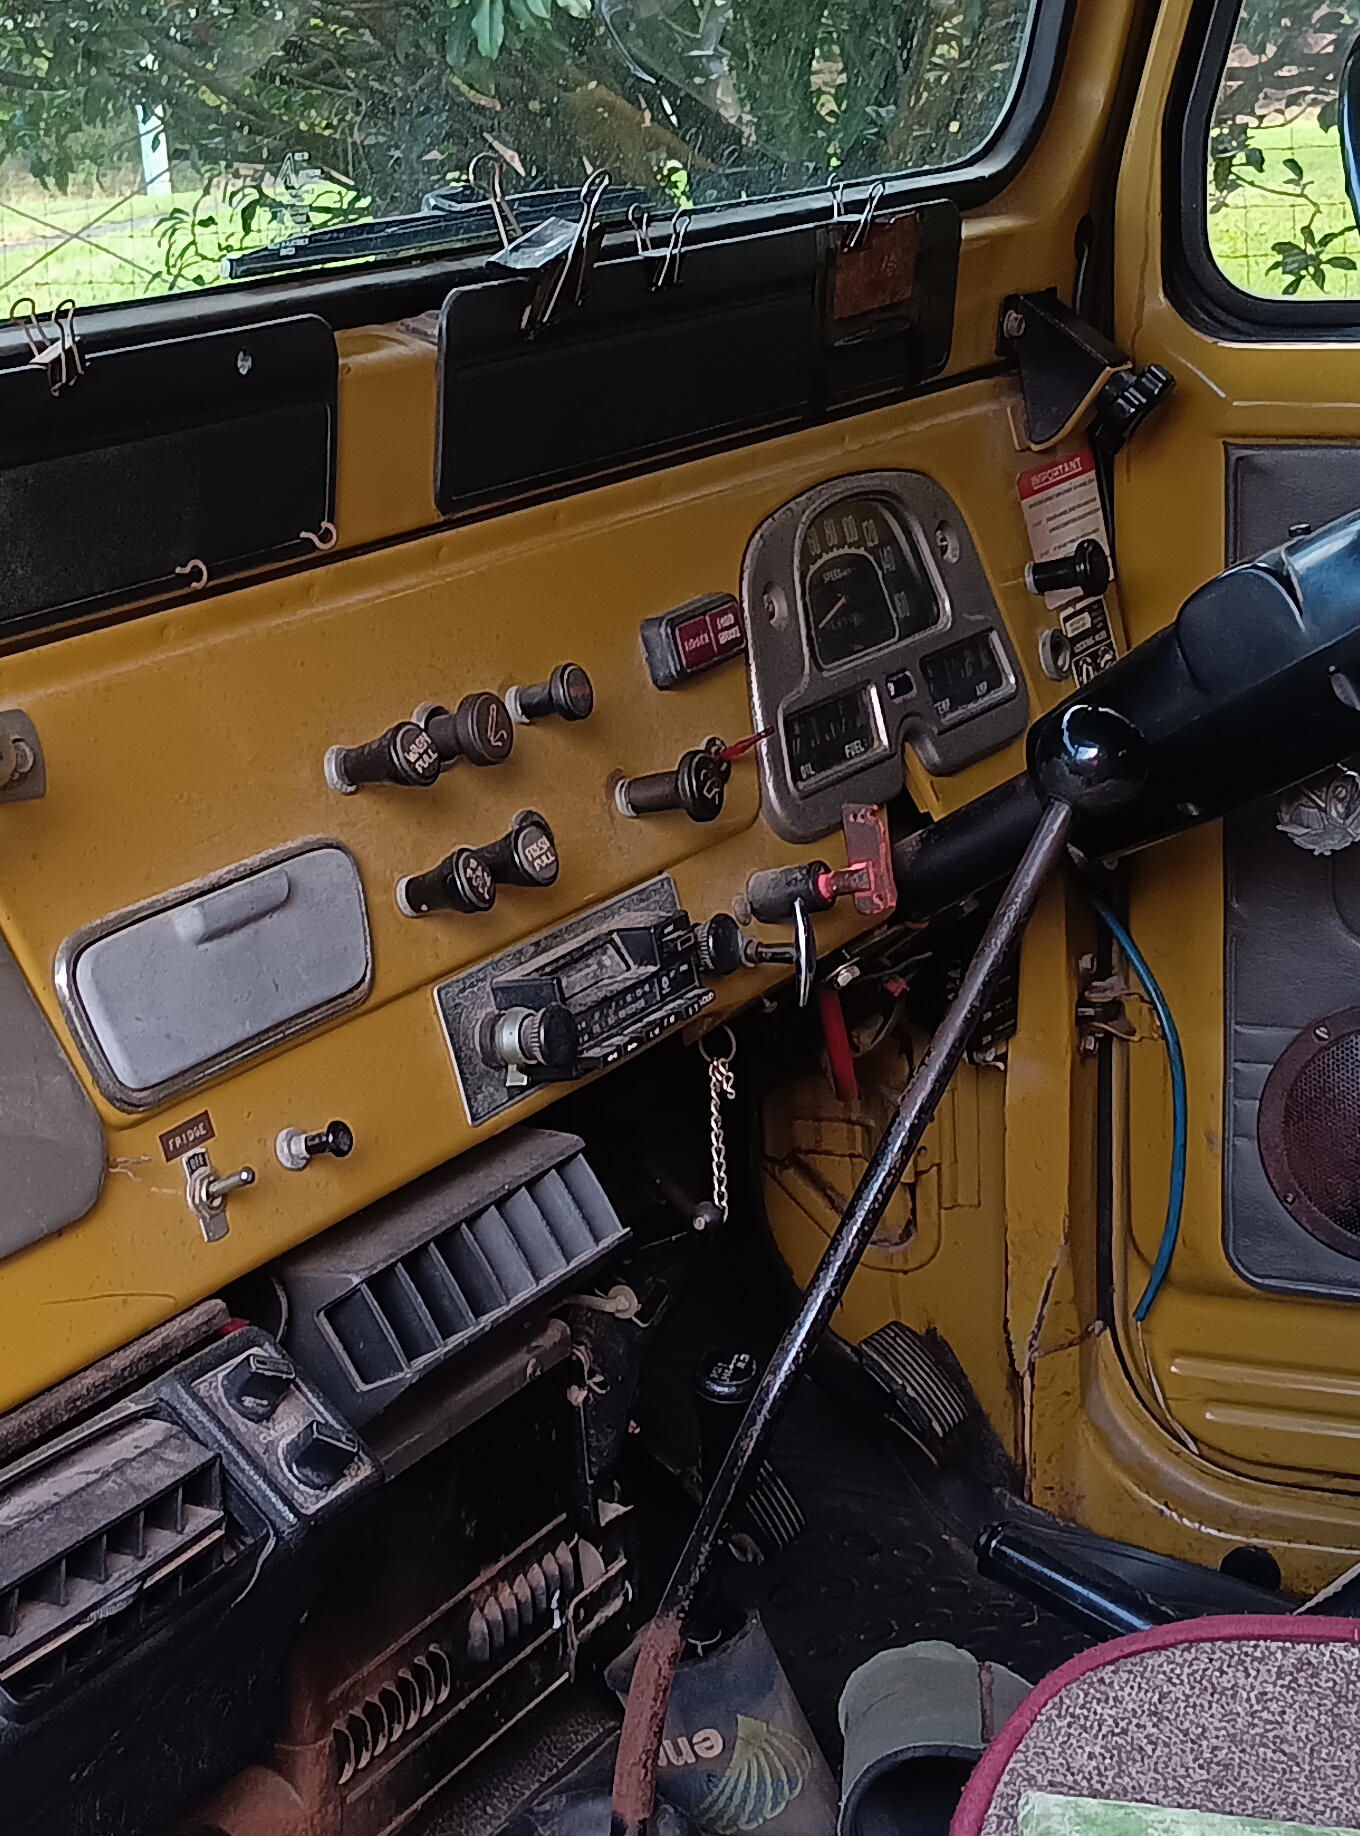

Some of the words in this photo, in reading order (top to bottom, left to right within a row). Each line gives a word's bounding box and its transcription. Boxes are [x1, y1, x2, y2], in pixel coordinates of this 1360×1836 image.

[1031, 457, 1082, 487] IMPORTANT
[404, 731, 432, 762] WASH
[415, 751, 438, 774] PULL
[534, 851, 555, 871] PULL
[168, 1121, 207, 1152] FRIDGE
